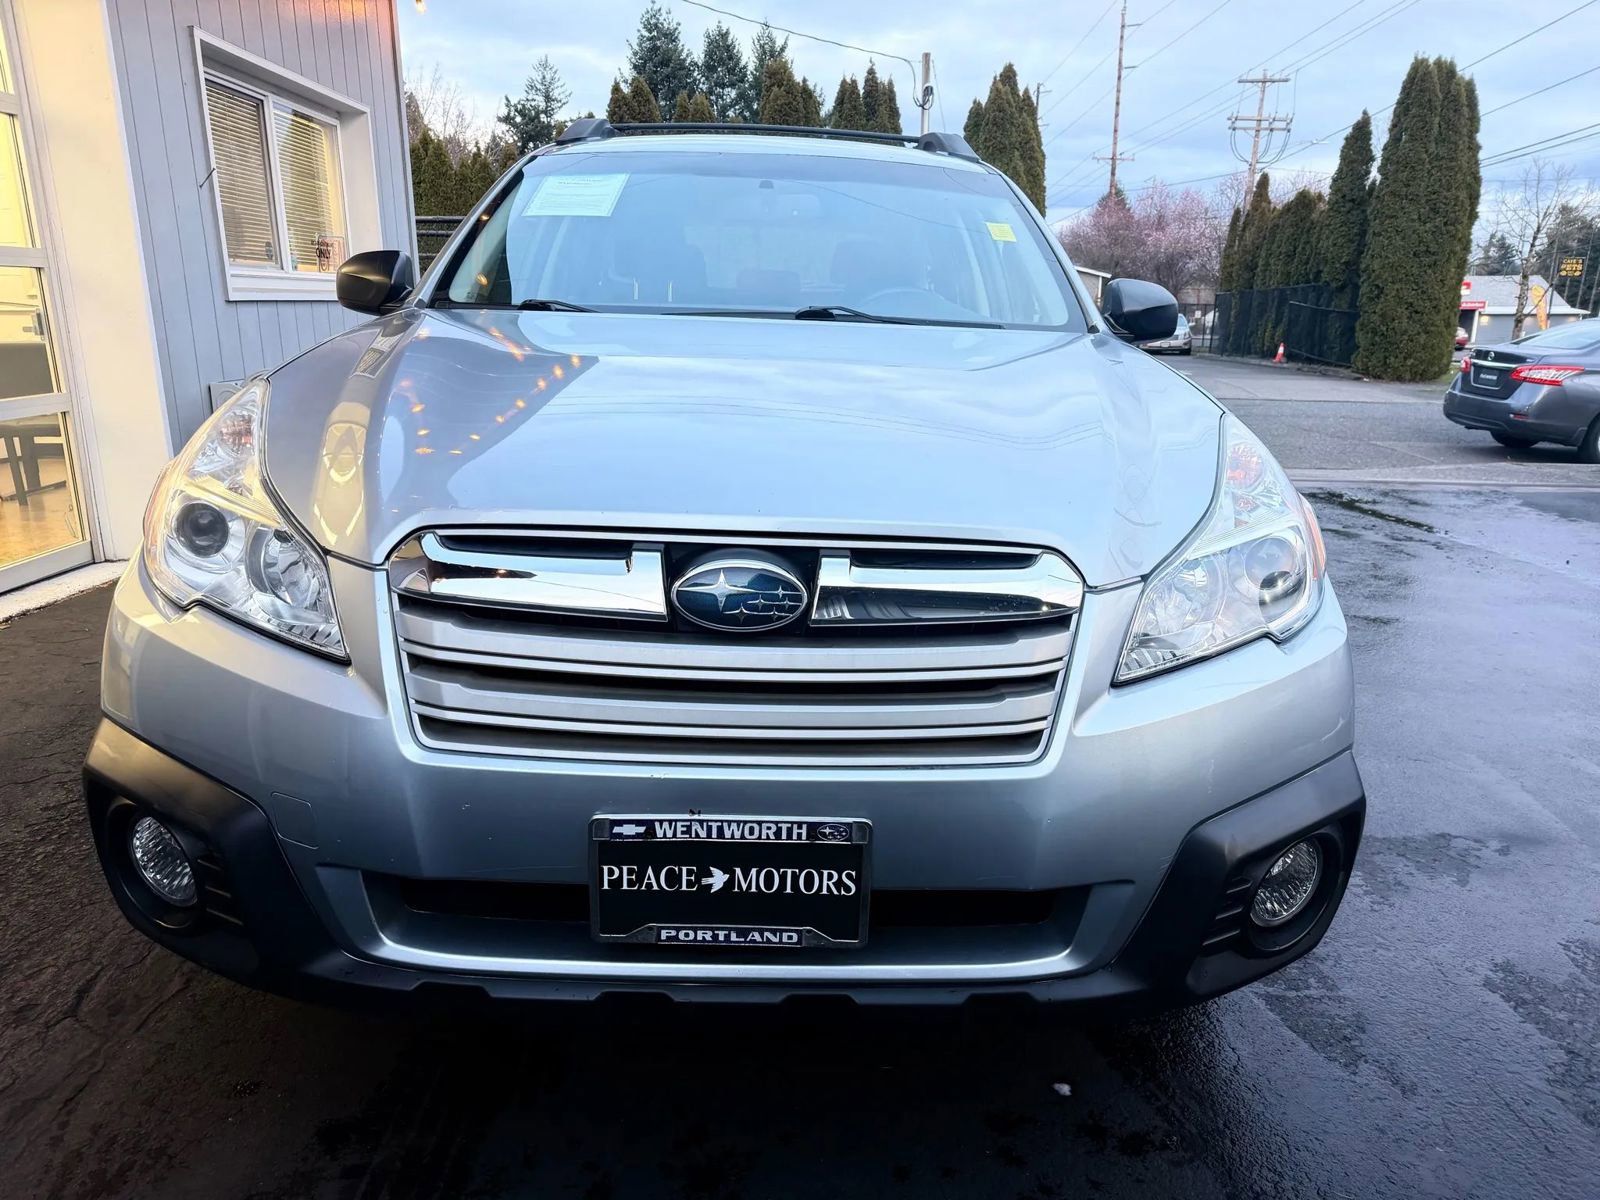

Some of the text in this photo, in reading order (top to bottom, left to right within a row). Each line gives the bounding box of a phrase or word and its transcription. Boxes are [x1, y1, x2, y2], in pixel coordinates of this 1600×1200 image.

[654, 821, 807, 840] WENTWORTH
[600, 865, 856, 896] PEACE MOTORS
[660, 929, 799, 943] PORTLAND
